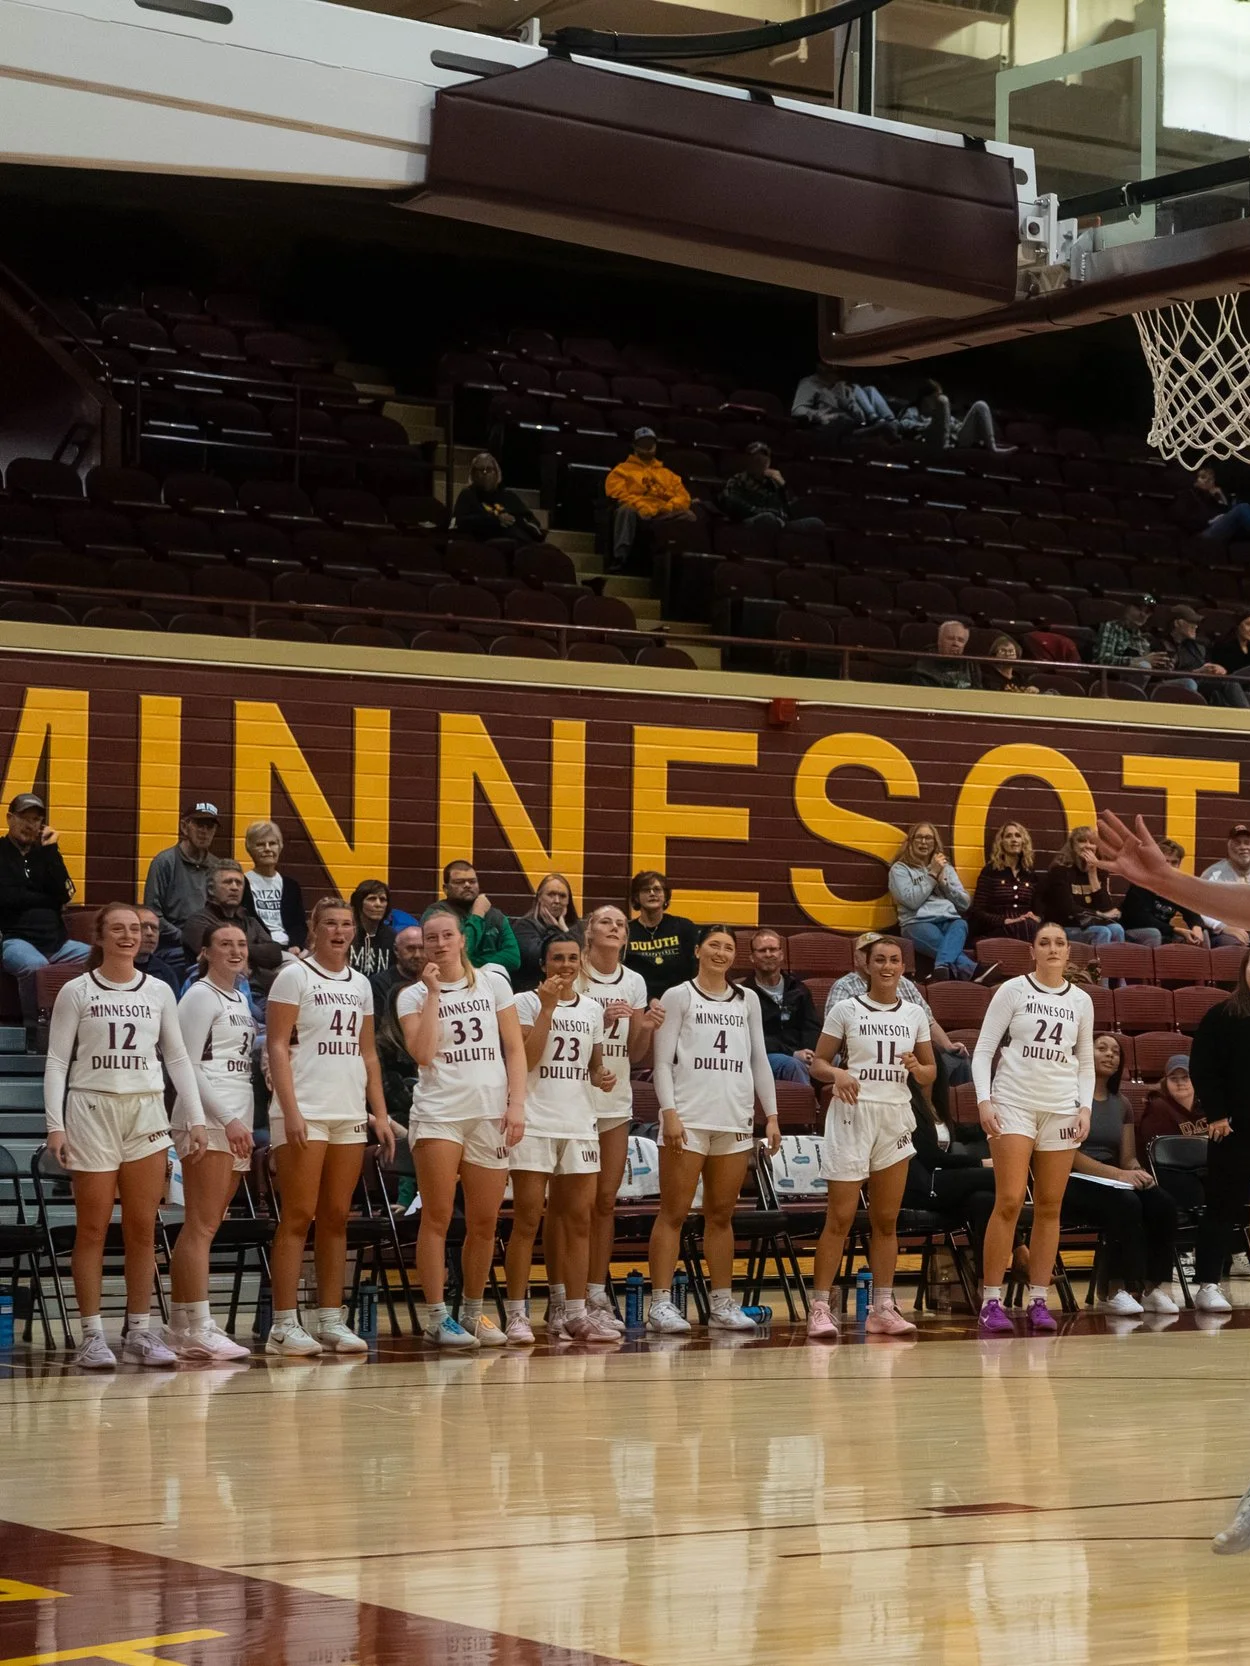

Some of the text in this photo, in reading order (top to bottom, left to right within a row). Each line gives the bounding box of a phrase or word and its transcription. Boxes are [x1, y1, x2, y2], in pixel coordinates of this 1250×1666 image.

[630, 936, 679, 951] DULUTH
[314, 992, 362, 1007] MINNESO
[91, 1004, 152, 1019] MINNESOTA
[1026, 1003, 1075, 1023] MINNESOTA
[330, 1009, 357, 1037] 44
[549, 1018, 590, 1035] NNESOTA
[695, 1013, 744, 1028] MINNESOTA
[108, 1022, 137, 1051] 12
[451, 1017, 484, 1046] 33
[859, 1023, 911, 1039] MINNESOTA
[1033, 1019, 1063, 1046] 24
[318, 1042, 361, 1057] DULUT
[552, 1036, 580, 1062] 23
[713, 1030, 728, 1054] 4
[444, 1047, 496, 1064] DULUTH
[876, 1041, 896, 1065] 11
[92, 1055, 149, 1071] DULUTH
[694, 1057, 744, 1074] DULUTH
[540, 1065, 590, 1082] DULUTH
[1060, 1127, 1077, 1140] UM
